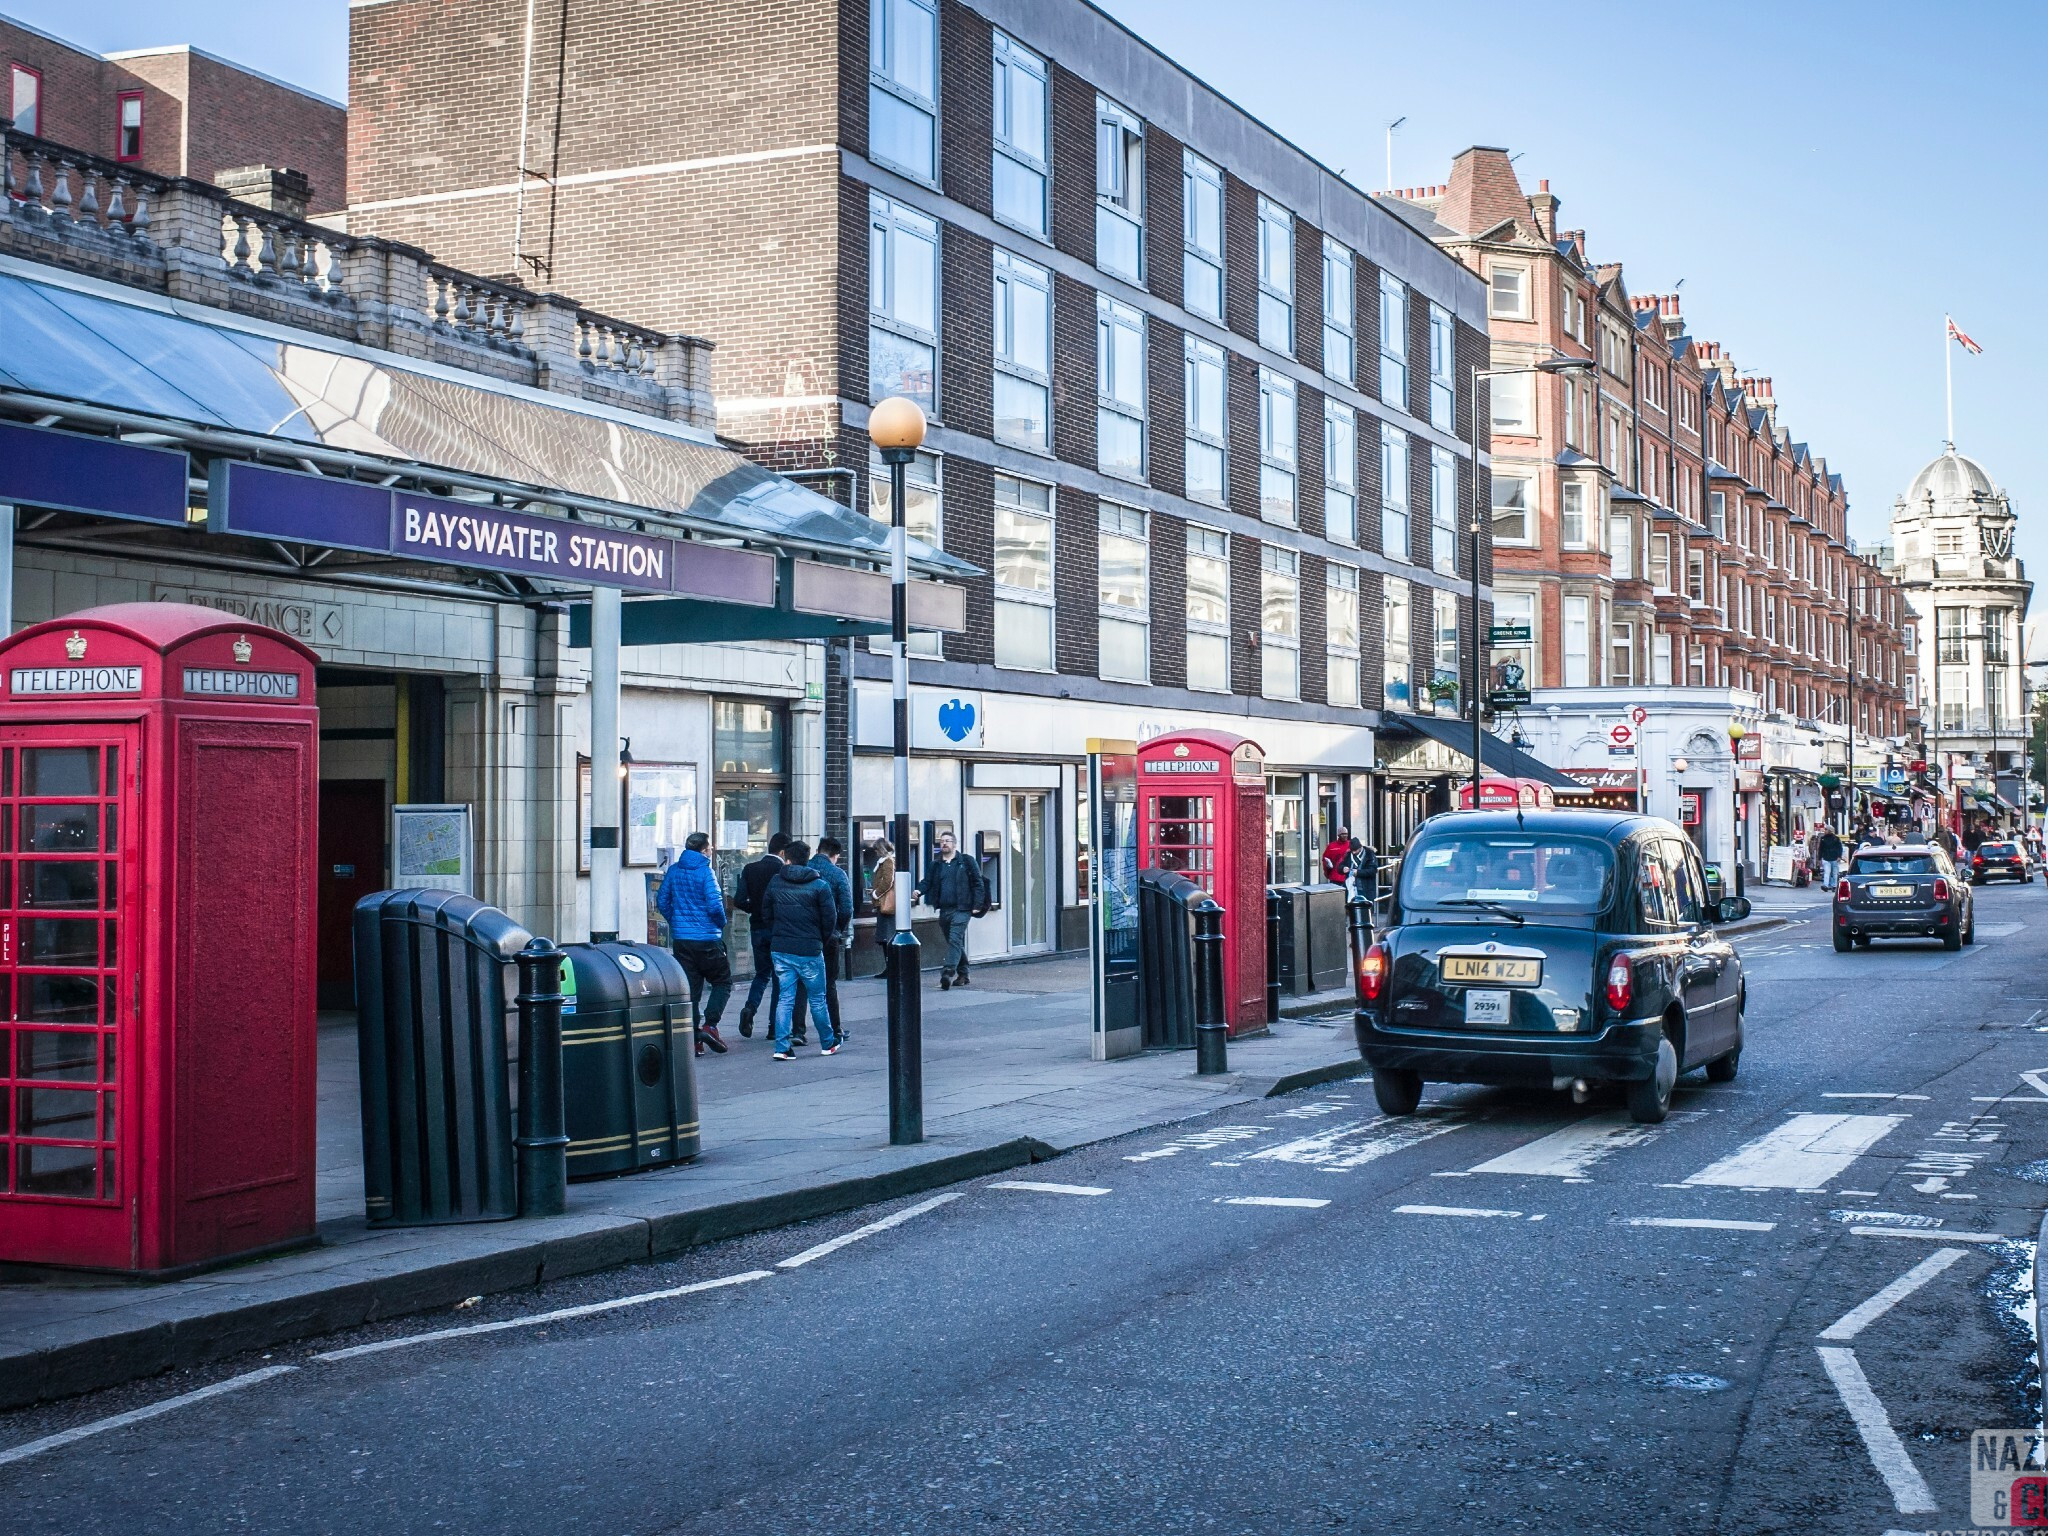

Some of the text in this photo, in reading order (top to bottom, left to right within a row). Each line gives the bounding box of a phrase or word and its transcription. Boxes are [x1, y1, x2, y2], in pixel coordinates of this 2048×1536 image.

[405, 508, 663, 579] BAYSWATER STATION
[190, 595, 313, 637] RANCE
[16, 669, 137, 691] TELEPHONE
[186, 671, 294, 695] TELEPHONE
[1148, 760, 1217, 772] TELEPHONE
[1599, 772, 1628, 787] Hut
[1468, 796, 1511, 804] EPHONE
[1454, 961, 1528, 979] LN14 WZJ
[1474, 1002, 1501, 1011] 29391
